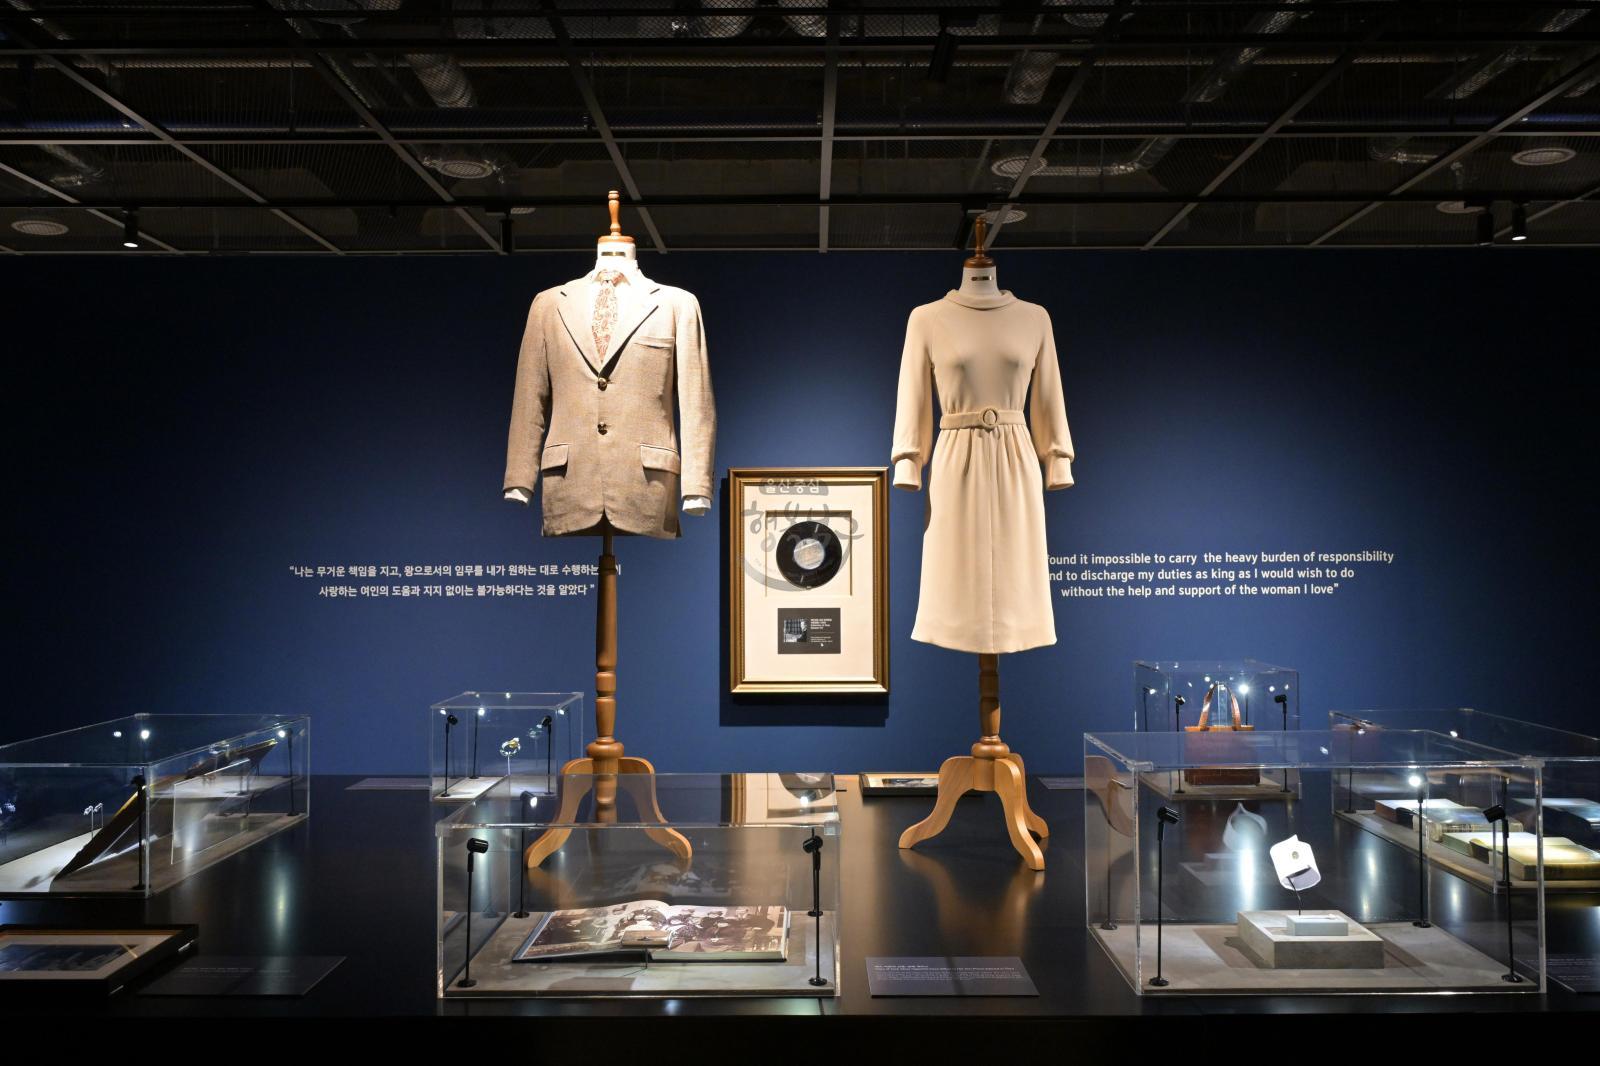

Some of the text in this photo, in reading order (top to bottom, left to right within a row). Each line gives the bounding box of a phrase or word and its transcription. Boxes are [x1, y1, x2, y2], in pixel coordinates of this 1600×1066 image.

[1080, 553, 1088, 565] it
[1091, 552, 1151, 567] impossible
[1154, 553, 1166, 564] to
[1168, 554, 1198, 566] carry
[1203, 551, 1222, 563] the
[1225, 551, 1258, 565] heavy
[1261, 551, 1300, 563] burden
[1303, 551, 1316, 562] of
[1318, 550, 1394, 564] responsibility
[316, 565, 346, 578] 무거운
[348, 565, 378, 577] 책임을
[380, 564, 402, 579] 지고,
[404, 564, 452, 577] 왕으로서의
[454, 564, 484, 577] 임무를
[486, 564, 506, 577] 내가
[508, 564, 537, 577] 원하는
[539, 564, 559, 576] 대로
[561, 563, 600, 576] 수행하는
[1066, 571, 1078, 581] to
[1080, 569, 1135, 583] discharge
[1137, 571, 1155, 582] my
[1157, 569, 1193, 580] duties
[1195, 570, 1208, 579] as
[1211, 568, 1235, 582] king
[1238, 570, 1251, 579] as
[1254, 568, 1258, 578] I
[1261, 568, 1294, 579] would
[1297, 567, 1323, 578] wish
[1325, 568, 1338, 578] to
[1340, 567, 1355, 578] do
[318, 585, 358, 598] 사랑하는
[360, 585, 389, 597] 여인의
[391, 585, 421, 597] 도움과
[423, 584, 442, 597] 지지
[445, 584, 474, 597] 없이는
[476, 584, 535, 597] 불가능하다는
[537, 584, 556, 597] 것을
[1060, 586, 1104, 597] without
[1106, 585, 1125, 597] the
[1128, 585, 1152, 598] help
[1155, 584, 1175, 596] and
[1178, 585, 1222, 598] support
[1224, 584, 1237, 595] of
[1239, 584, 1258, 595] the
[1261, 585, 1300, 595] woman
[1304, 583, 1308, 595] I
